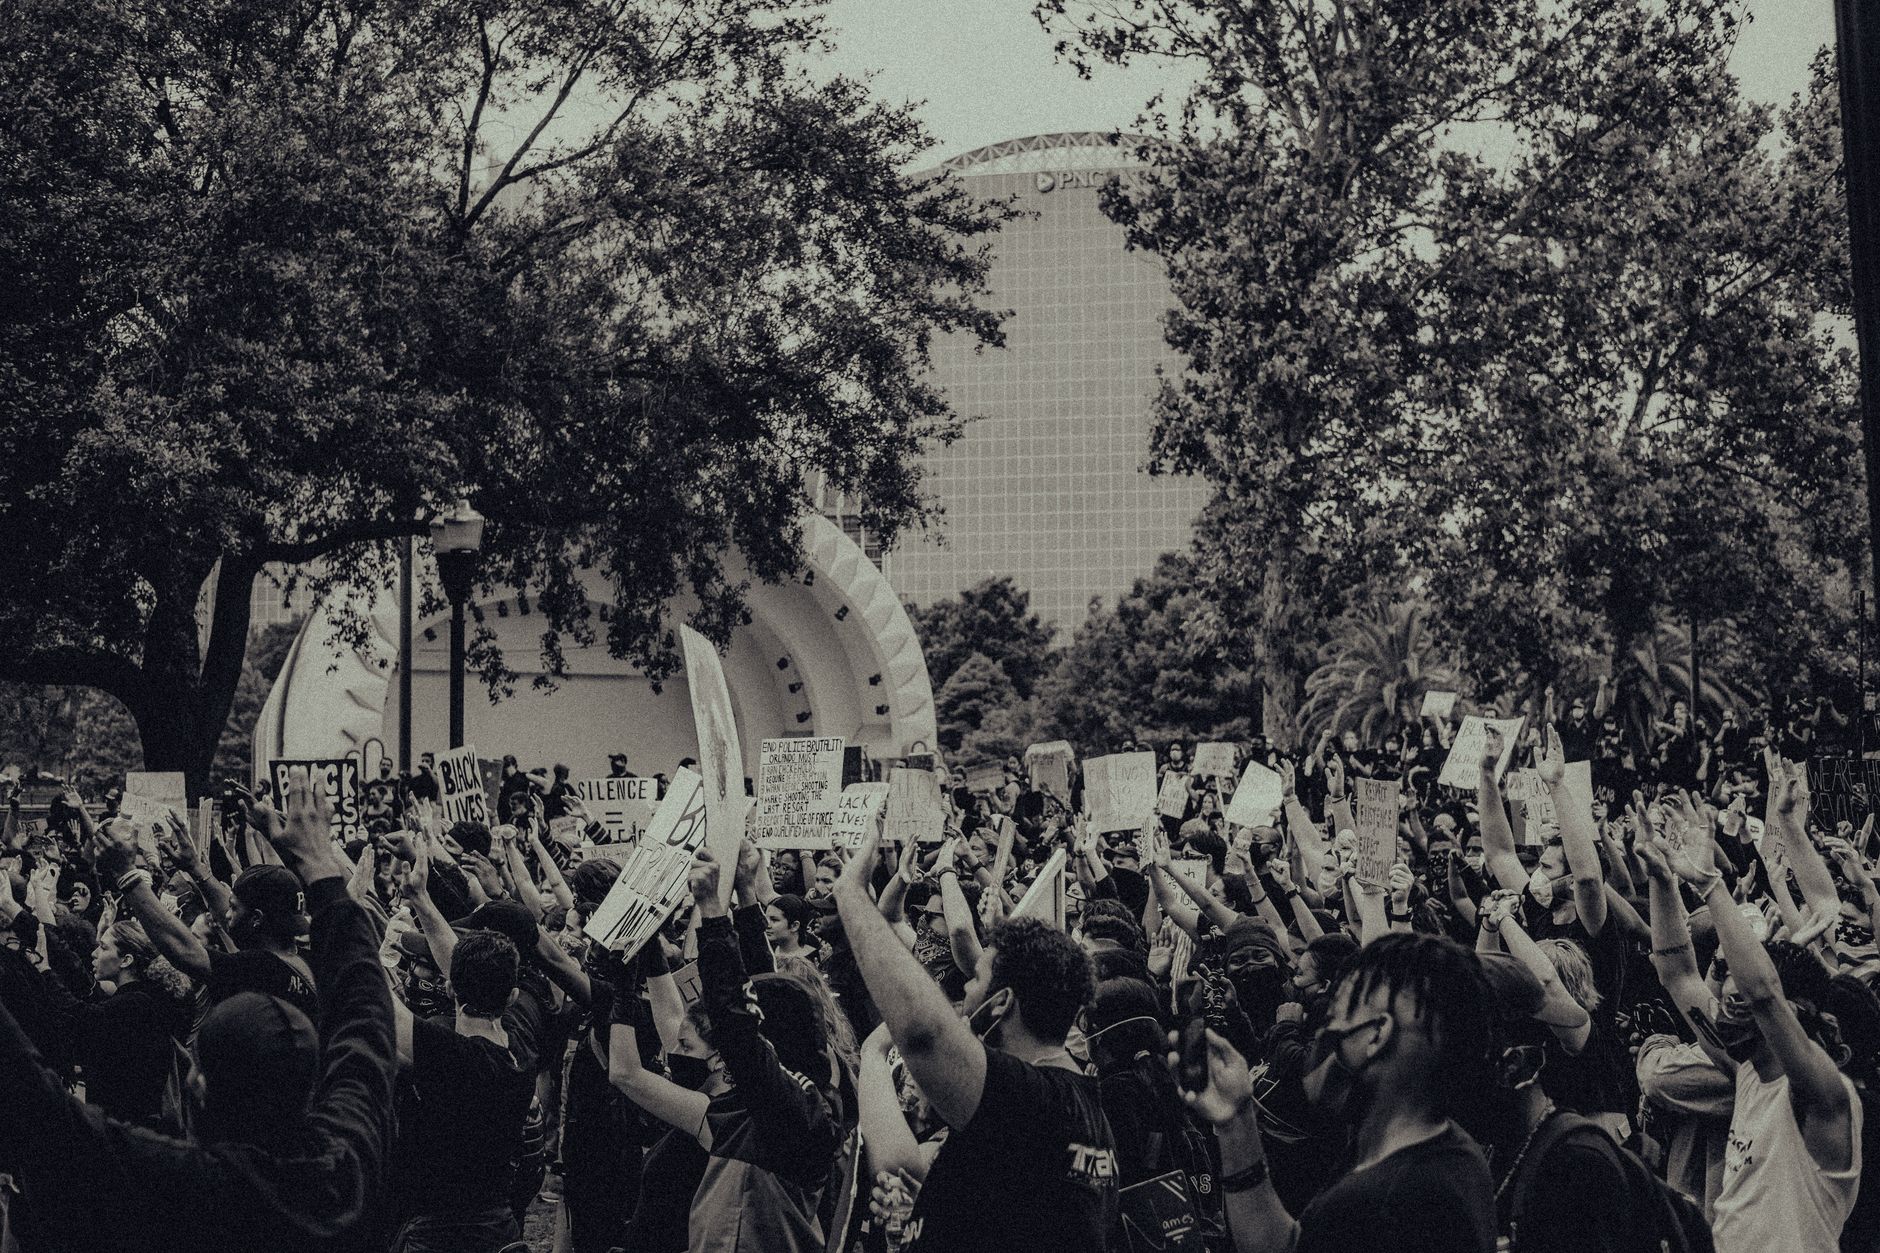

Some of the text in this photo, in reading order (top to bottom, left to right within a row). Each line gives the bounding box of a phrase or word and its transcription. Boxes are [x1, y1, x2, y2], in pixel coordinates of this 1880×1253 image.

[1060, 170, 1101, 189] PNC
[761, 738, 843, 753] END POLICE BRUTALITY
[769, 752, 817, 765] ORLANDO MUST
[276, 763, 356, 798] BCK
[1806, 758, 1830, 791] WE
[1831, 759, 1857, 791] ARE
[577, 779, 648, 801] SILENCE
[801, 780, 828, 791] SHOOTING
[764, 793, 783, 804] MAKE
[784, 791, 810, 802] SHOOTING
[811, 790, 822, 801] THE
[838, 794, 869, 809] LACK
[447, 794, 486, 822] LIVES
[763, 801, 809, 814] LAST RESORT
[784, 813, 796, 826] ALL
[796, 812, 807, 825] USE
[814, 811, 834, 826] FORCE
[762, 827, 774, 838] END
